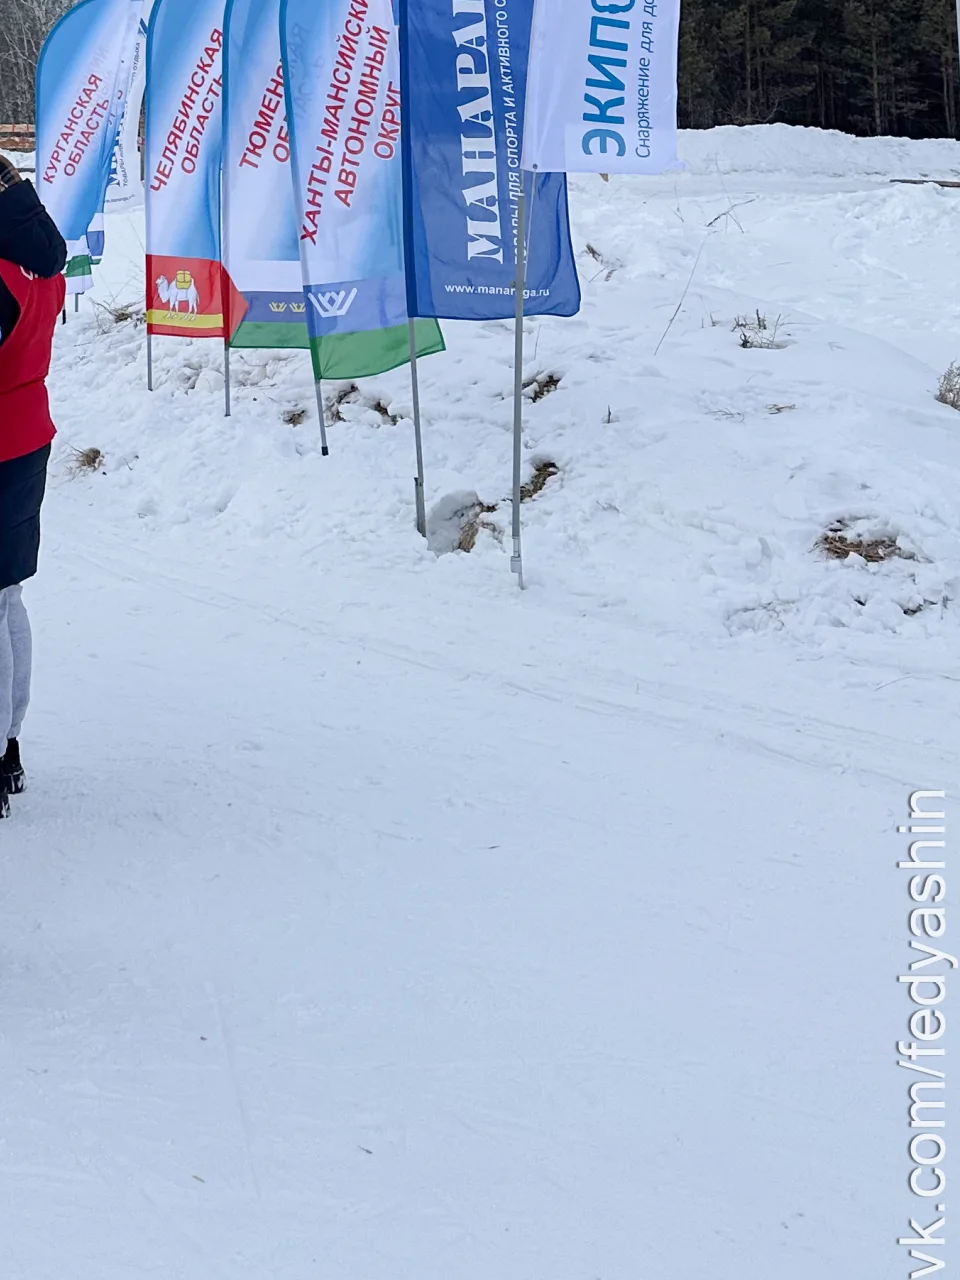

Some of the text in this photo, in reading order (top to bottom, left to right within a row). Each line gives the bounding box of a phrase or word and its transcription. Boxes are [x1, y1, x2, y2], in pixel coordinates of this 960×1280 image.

[496, 10, 514, 94] АКТИВНОГО
[641, 21, 654, 53] для
[42, 73, 103, 184] КУРГАНСКАЯ
[63, 99, 110, 177] ОБЛАСТЬ
[149, 28, 223, 192] ЧЕЛЯБИНСКАЯ
[239, 58, 284, 169] ТЮМЕН
[334, 25, 390, 208] АВТОНОМНЫЙ
[373, 81, 402, 160] ОКРУГ
[503, 97, 515, 108] И
[505, 111, 519, 167] СПОРТА
[636, 57, 653, 158] Снаряжение
[445, 284, 550, 299] www.manarga.ru
